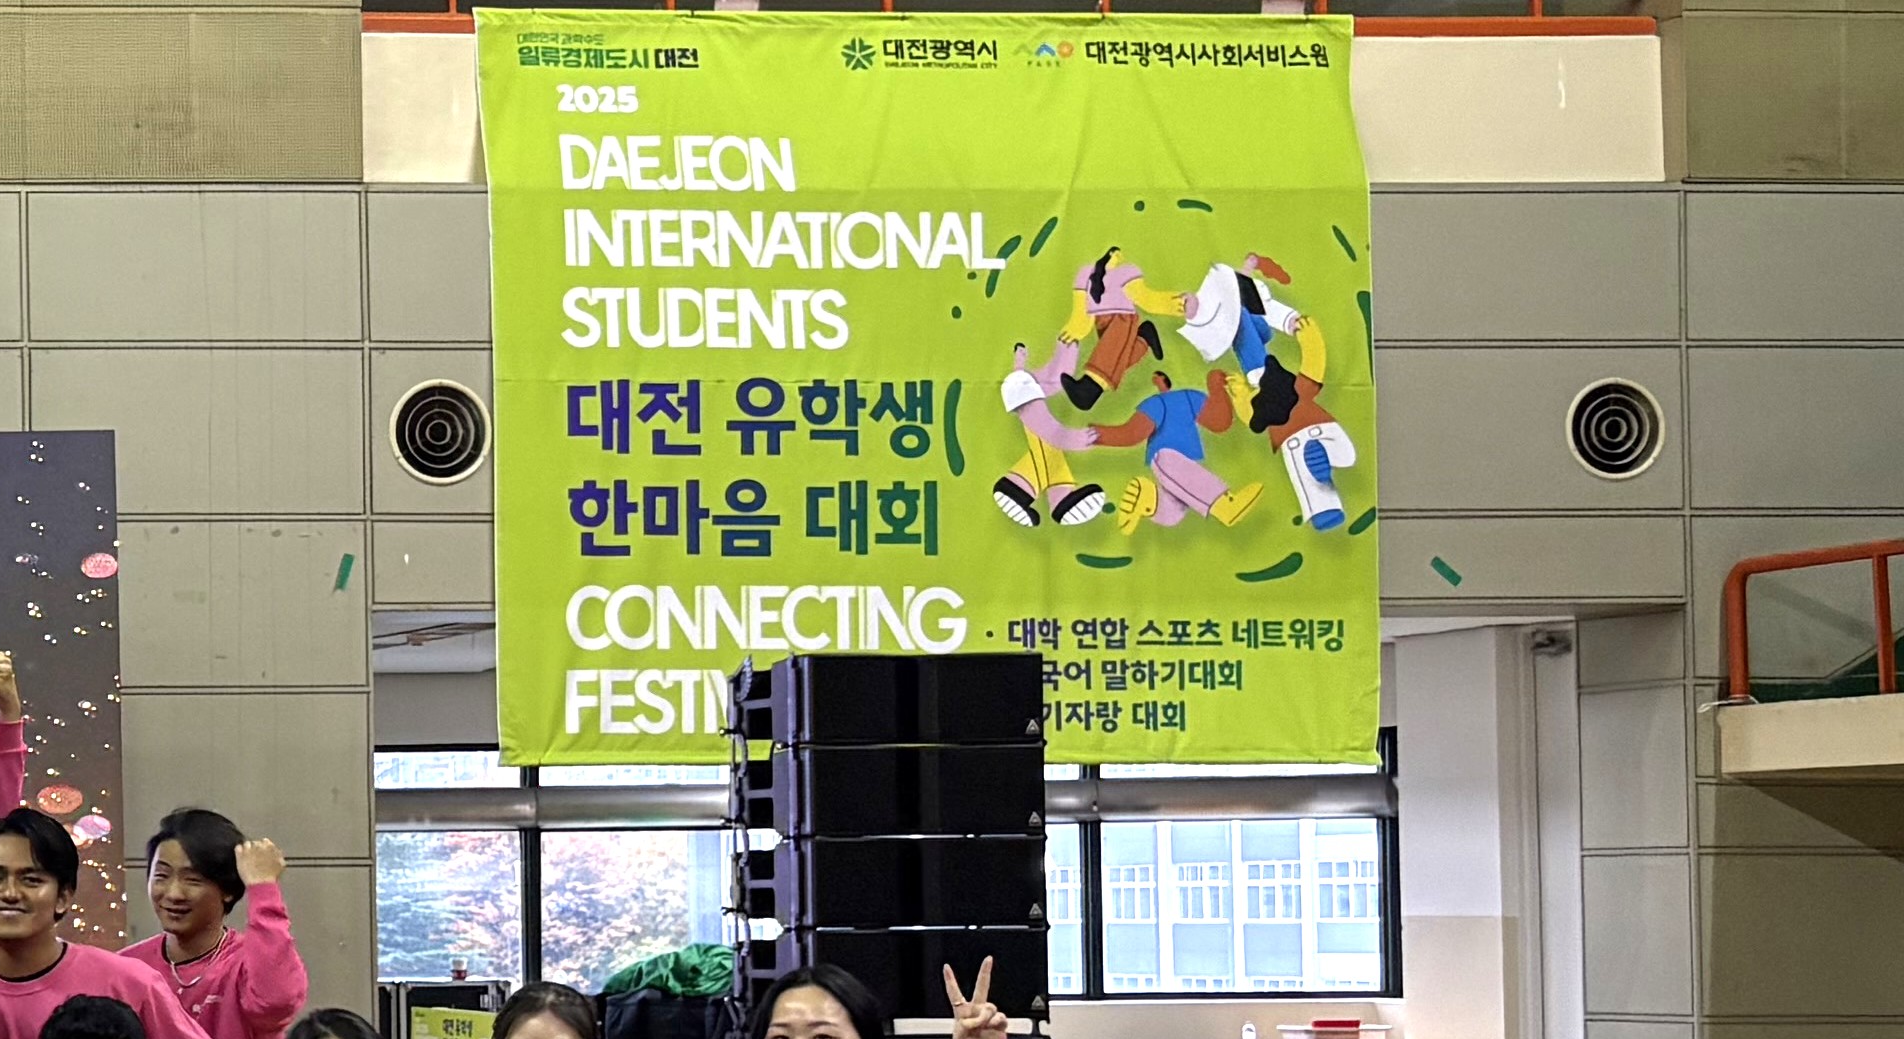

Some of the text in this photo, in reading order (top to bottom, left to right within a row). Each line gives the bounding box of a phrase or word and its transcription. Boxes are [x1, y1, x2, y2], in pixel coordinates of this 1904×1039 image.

[518, 46, 700, 69] 일류경제도시 대전
[883, 38, 998, 62] 대전광역시
[1085, 40, 1330, 69] 대전광역시사회서비스원
[556, 84, 639, 113] 2025
[558, 133, 797, 192] DAEJEON
[563, 208, 1006, 271] INTERNATIONAL
[560, 286, 849, 350] STUDENTS
[567, 377, 934, 458] 대전 유학생
[568, 478, 939, 557] 한마음 대회
[565, 584, 968, 655] CONNECTING
[1008, 617, 1345, 652] 대학 연합 스포츠 네트워킹
[1042, 659, 1092, 692] 국어
[565, 668, 729, 735] FESTI
[1043, 700, 1187, 733] 기자랑 대회
